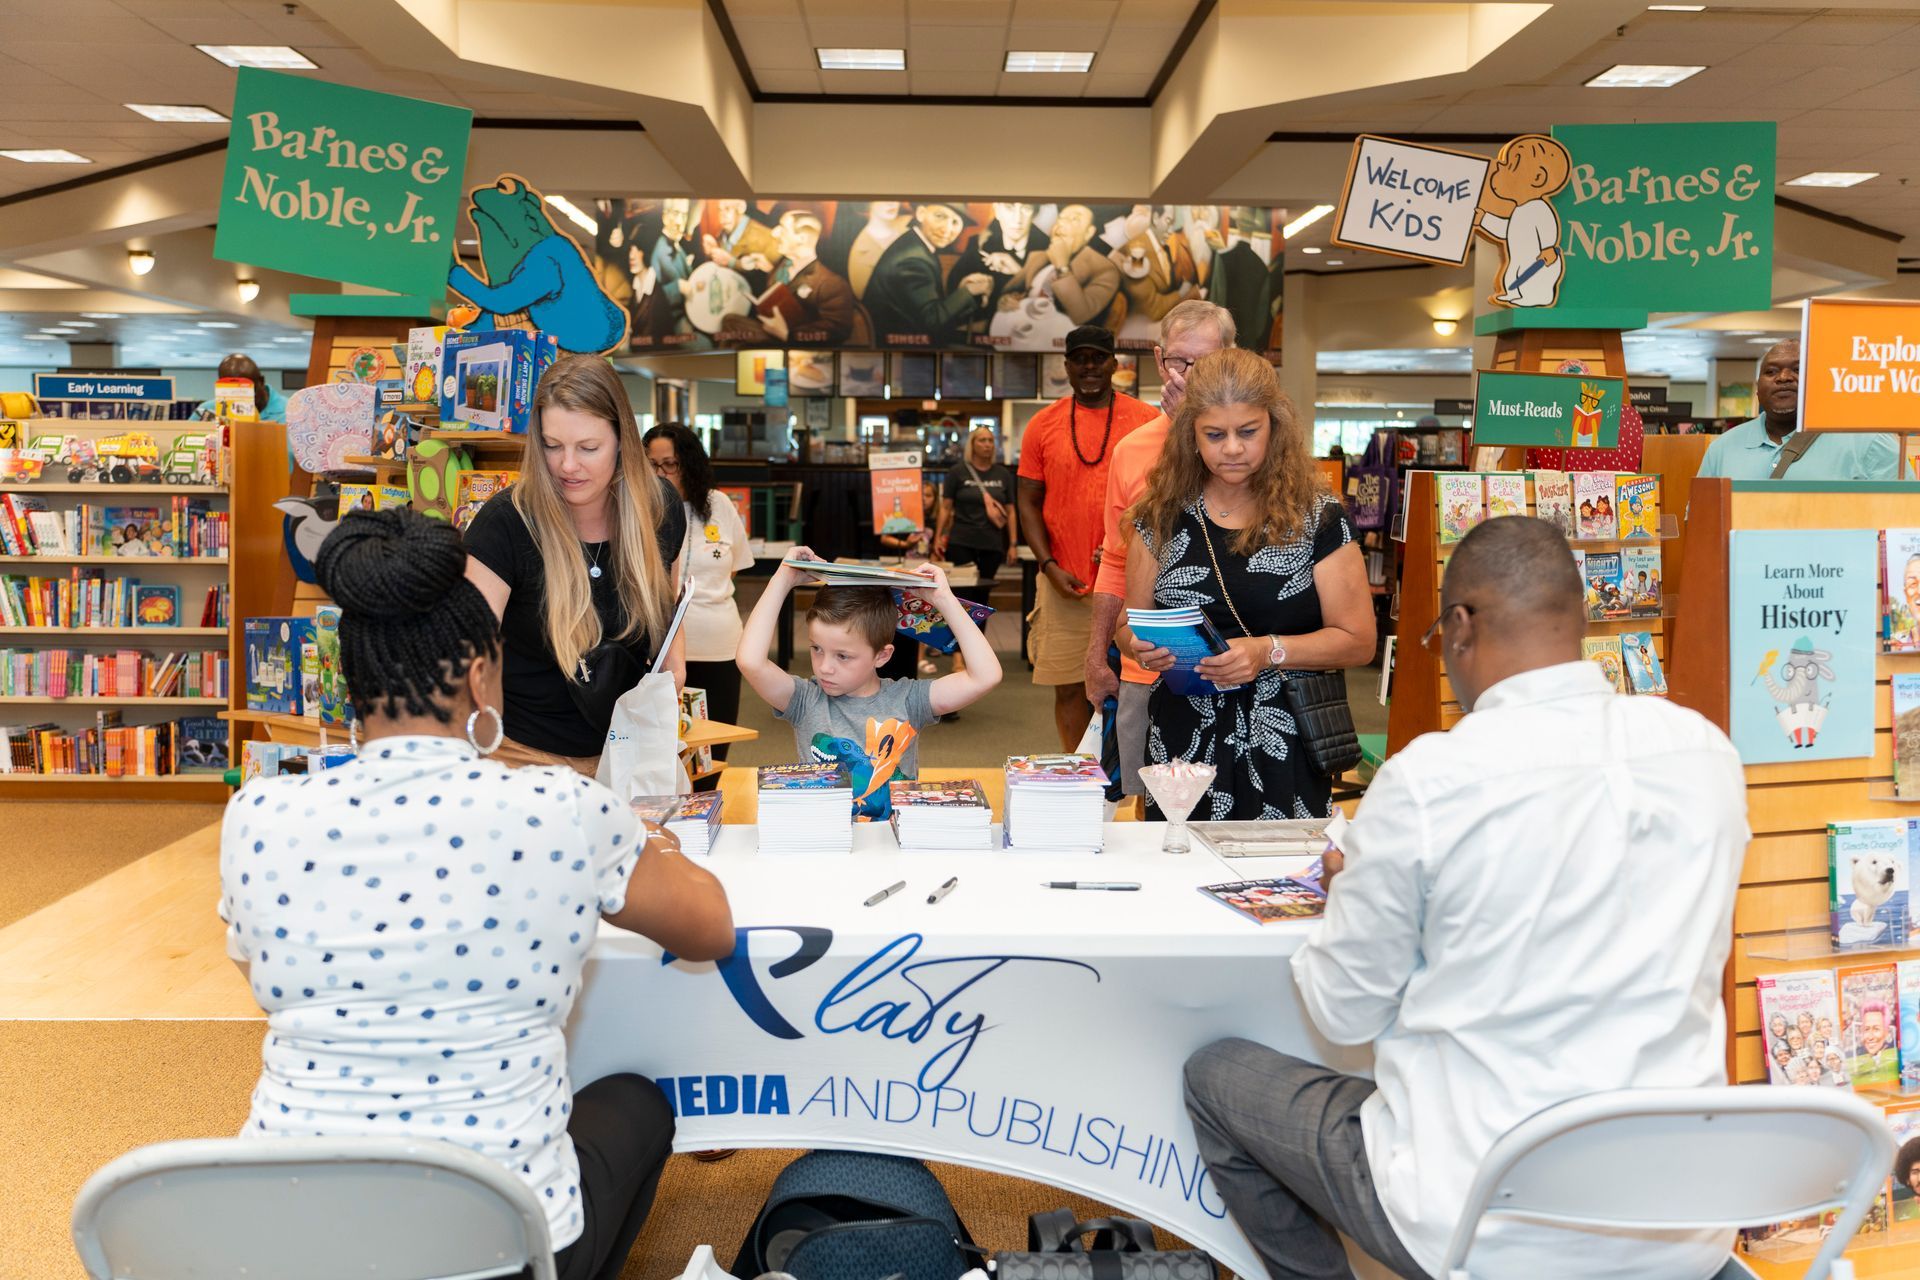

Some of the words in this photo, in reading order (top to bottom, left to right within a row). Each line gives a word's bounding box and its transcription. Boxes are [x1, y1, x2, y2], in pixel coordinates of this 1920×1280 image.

[247, 111, 408, 174] Barnes
[411, 147, 449, 184] &
[1366, 156, 1470, 204] WELCOME
[1570, 163, 1719, 205] Barnes
[1724, 164, 1760, 201] &
[235, 165, 377, 241] Noble,
[384, 191, 440, 243] Jr.
[1564, 220, 1699, 267] Noble,
[1706, 212, 1760, 262] Jr.
[67, 382, 95, 396] Early
[97, 383, 145, 397] Learning
[1829, 367, 1886, 393] Your
[1488, 399, 1563, 419] Must-Reads
[381, 486, 405, 498] Ladybug
[472, 482, 493, 493] BUGS
[1618, 481, 1656, 502] AWESOME
[1586, 557, 1617, 569] MIGHTY
[1764, 563, 1804, 580] Learn
[1808, 563, 1844, 579] More
[1782, 584, 1825, 599] About
[1761, 604, 1848, 635] History
[183, 717, 206, 729] Good
[207, 717, 229, 730] Nigh
[799, 1076, 921, 1124] AND
[932, 1086, 1227, 1219] PUBLISHING
